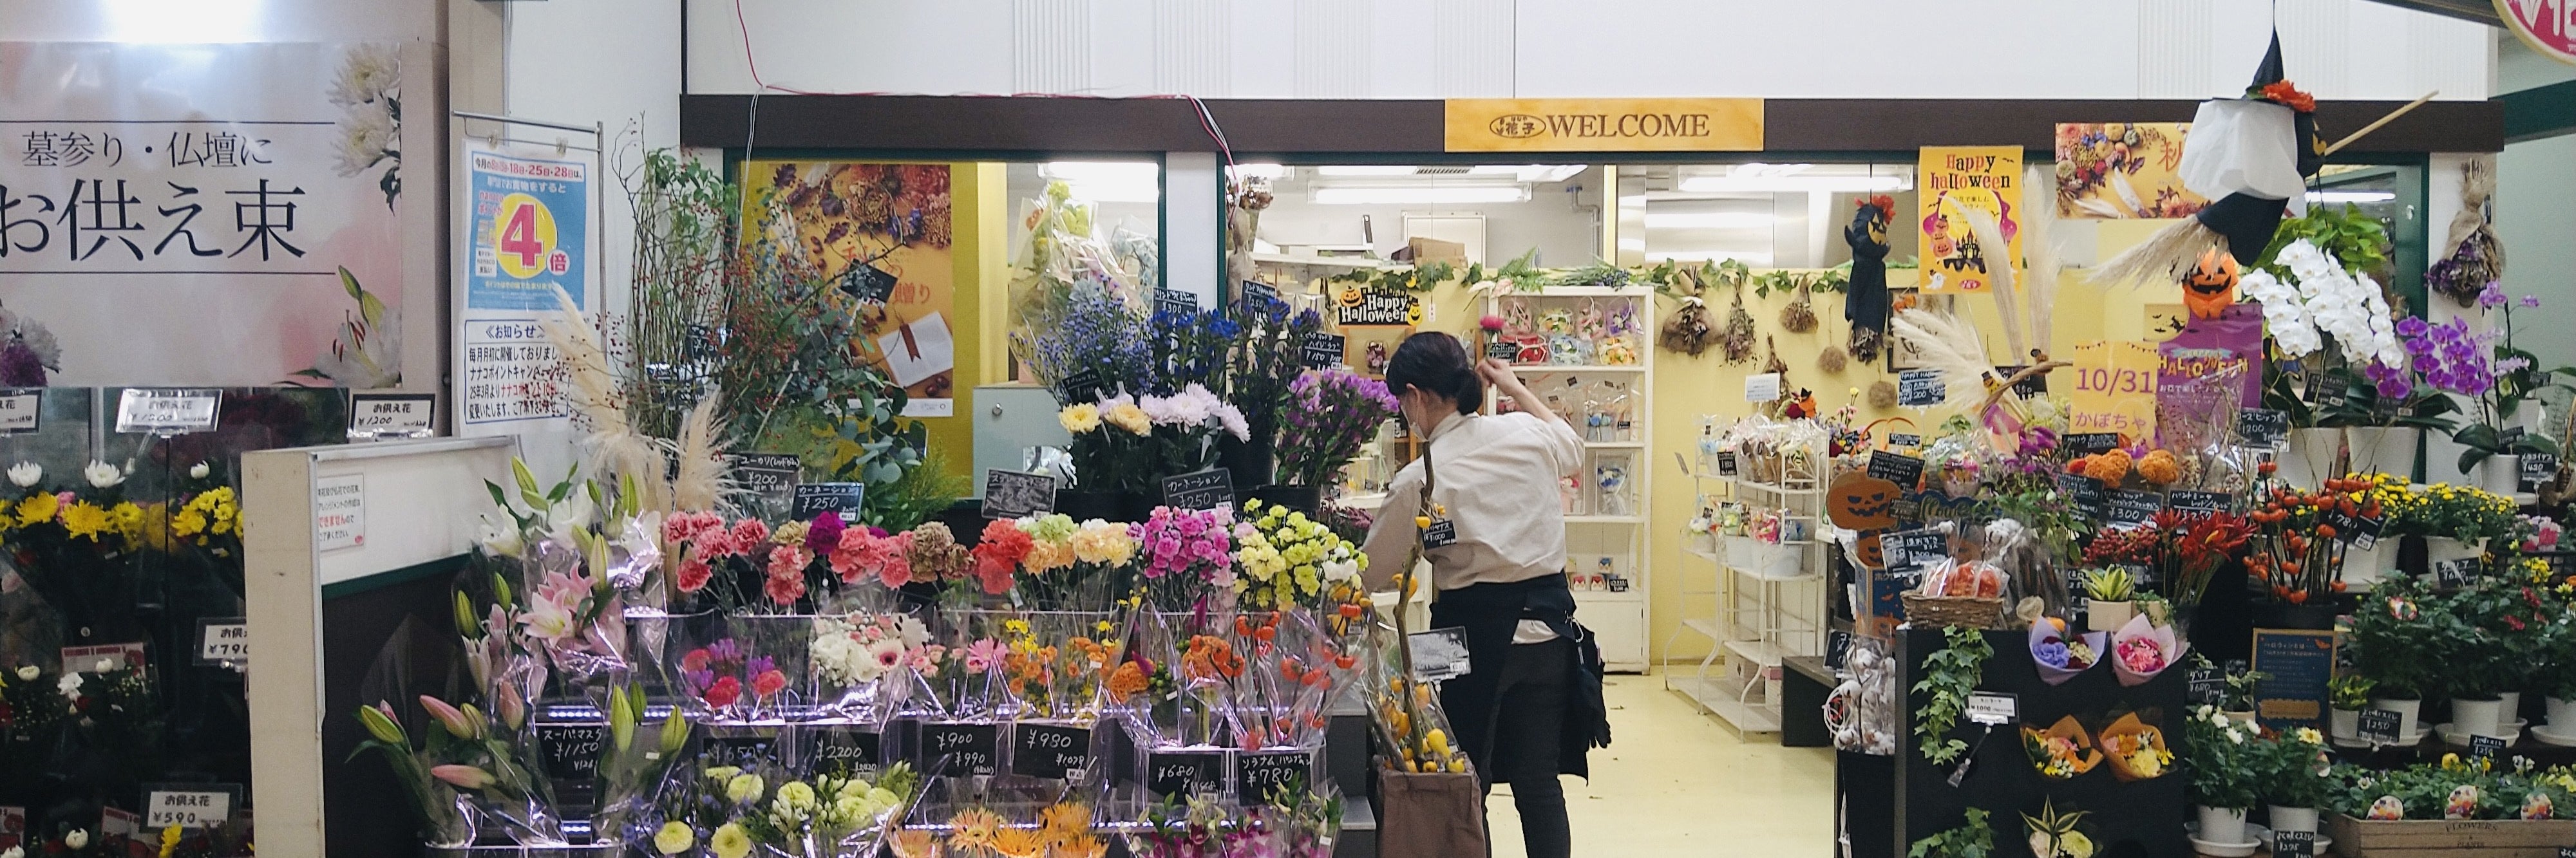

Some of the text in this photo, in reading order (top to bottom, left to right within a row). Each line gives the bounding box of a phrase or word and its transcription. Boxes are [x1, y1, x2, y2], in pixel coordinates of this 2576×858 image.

[1546, 114, 1710, 138] WELCOME
[22, 131, 273, 169] 墓参り・仏壇に
[1946, 154, 1996, 173] Happy
[1931, 172, 2010, 190] halloween
[0, 178, 306, 261] お供え束
[500, 202, 544, 269] 4
[549, 253, 567, 273] 倍
[1367, 294, 1408, 312] Happy
[1341, 304, 1408, 322] Halloween
[469, 346, 563, 363] 毎月月初に開催しておりまし
[2076, 368, 2153, 397] 10/31
[374, 403, 412, 413] お供え花
[359, 416, 392, 426] ¥1200
[2076, 411, 2146, 431] かぼちゃ
[748, 471, 777, 487] ¥200
[803, 496, 838, 513] ¥250
[1179, 492, 1211, 509] ¥250
[2108, 505, 2139, 519] ¥300
[936, 731, 972, 751] ¥900
[1027, 728, 1072, 750] ¥980
[554, 741, 599, 763] ¥1150
[817, 737, 862, 762] ¥2200
[955, 750, 985, 767] ¥990
[1158, 764, 1194, 783] ¥680
[1247, 767, 1294, 788] ¥780
[164, 794, 211, 807] お供え花
[153, 812, 196, 824] ¥590
